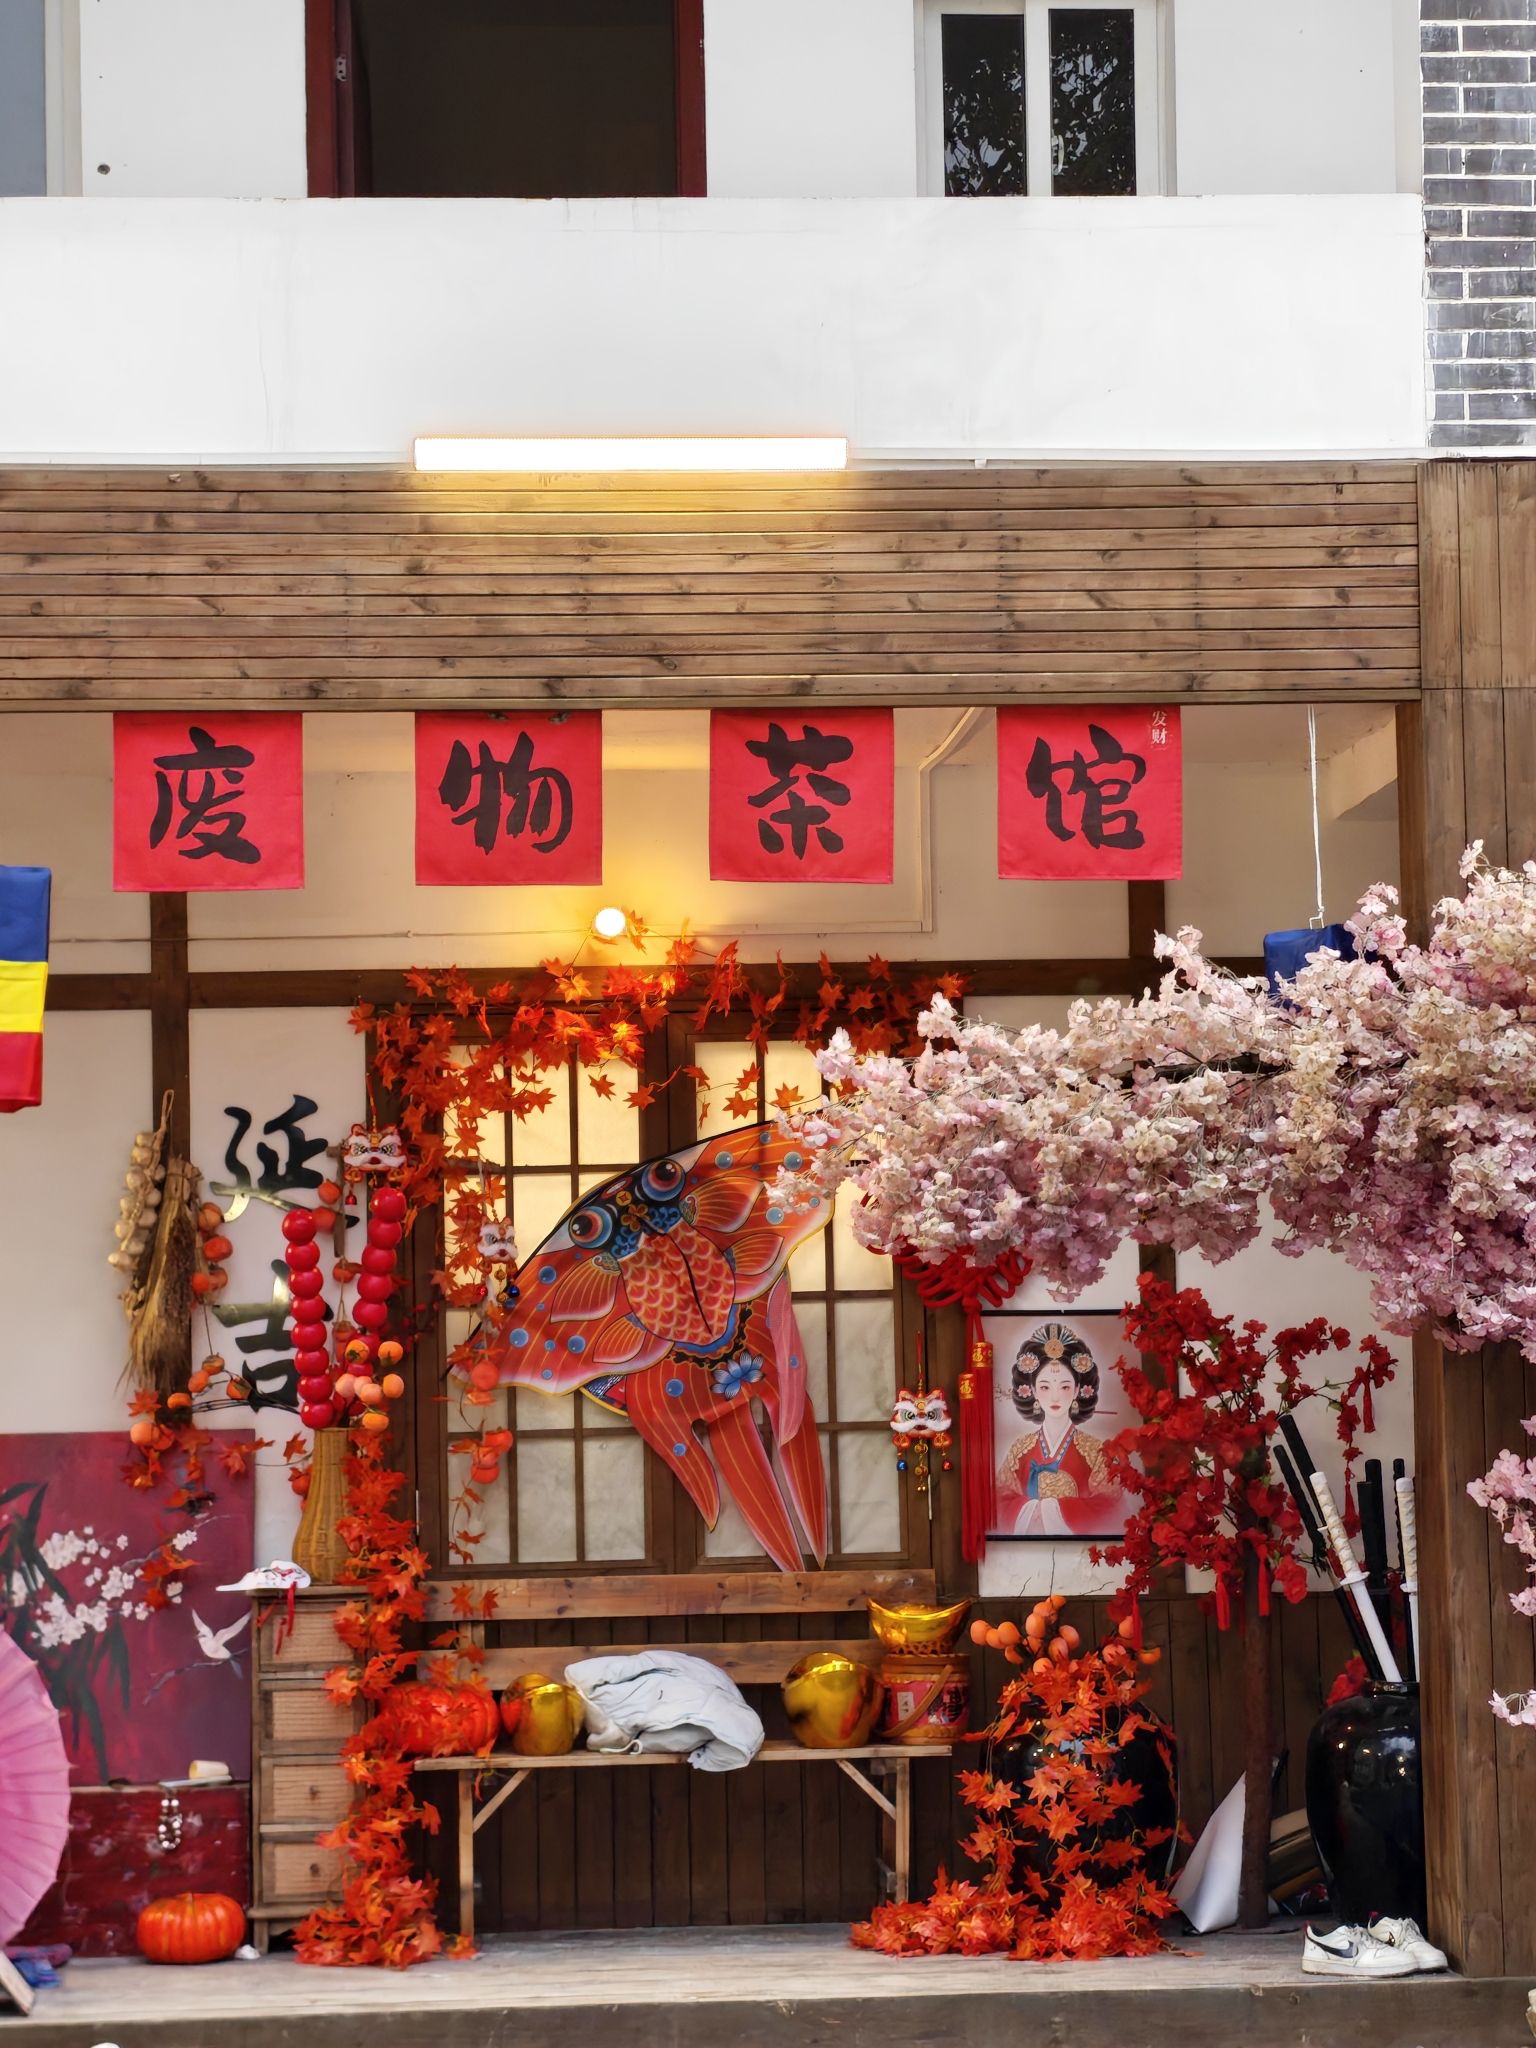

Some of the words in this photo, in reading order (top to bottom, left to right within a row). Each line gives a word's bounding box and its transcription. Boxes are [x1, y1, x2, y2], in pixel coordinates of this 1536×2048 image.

[150, 726, 261, 864] 废
[438, 731, 573, 855] 物
[745, 722, 854, 859] 茶
[1026, 723, 1147, 849] 馆
[1151, 710, 1168, 745] 发财
[209, 1094, 360, 1414] 延吉
